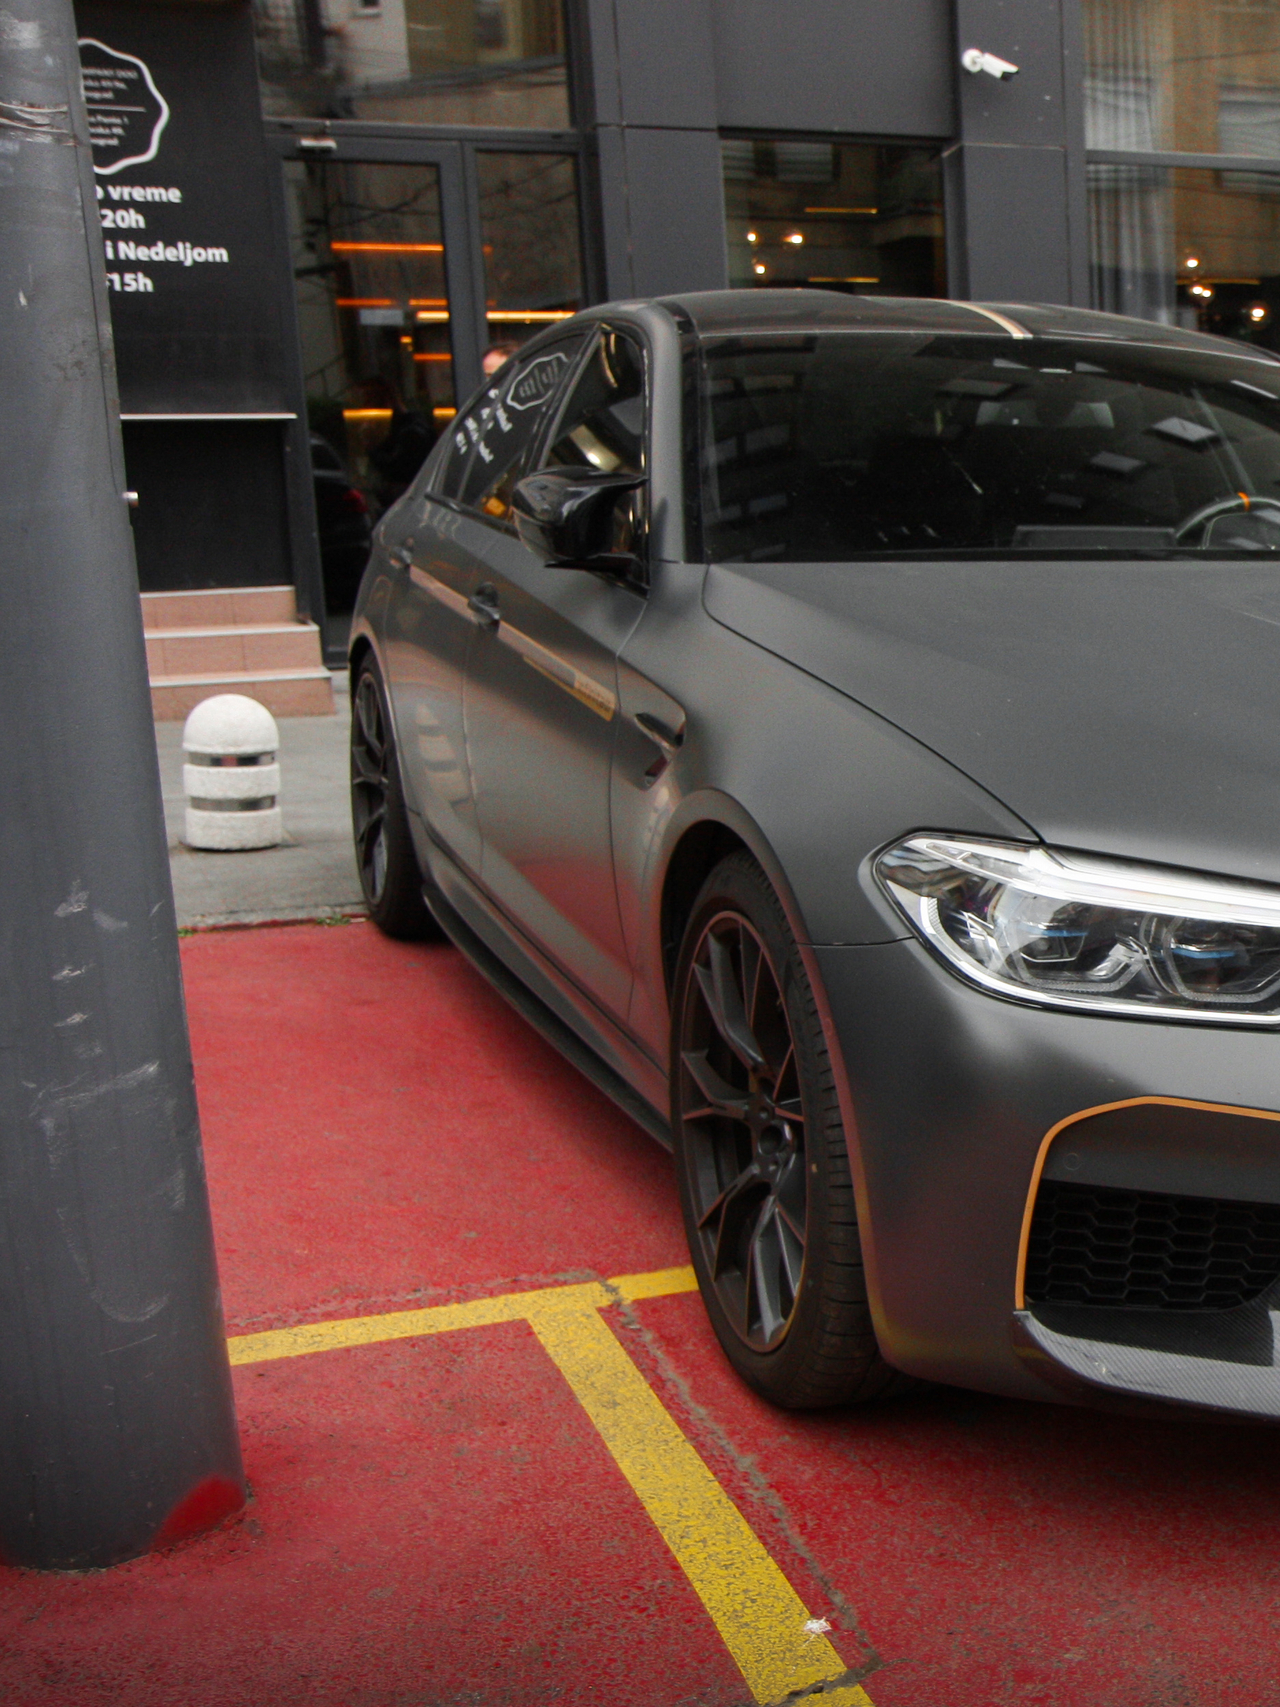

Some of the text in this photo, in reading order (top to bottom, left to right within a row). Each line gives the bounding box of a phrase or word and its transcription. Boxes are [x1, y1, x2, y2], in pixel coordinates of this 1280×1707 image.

[107, 185, 182, 203] vreme
[100, 208, 146, 229] 20h
[105, 240, 230, 267] i Nedeljom
[106, 271, 154, 292] 15h
